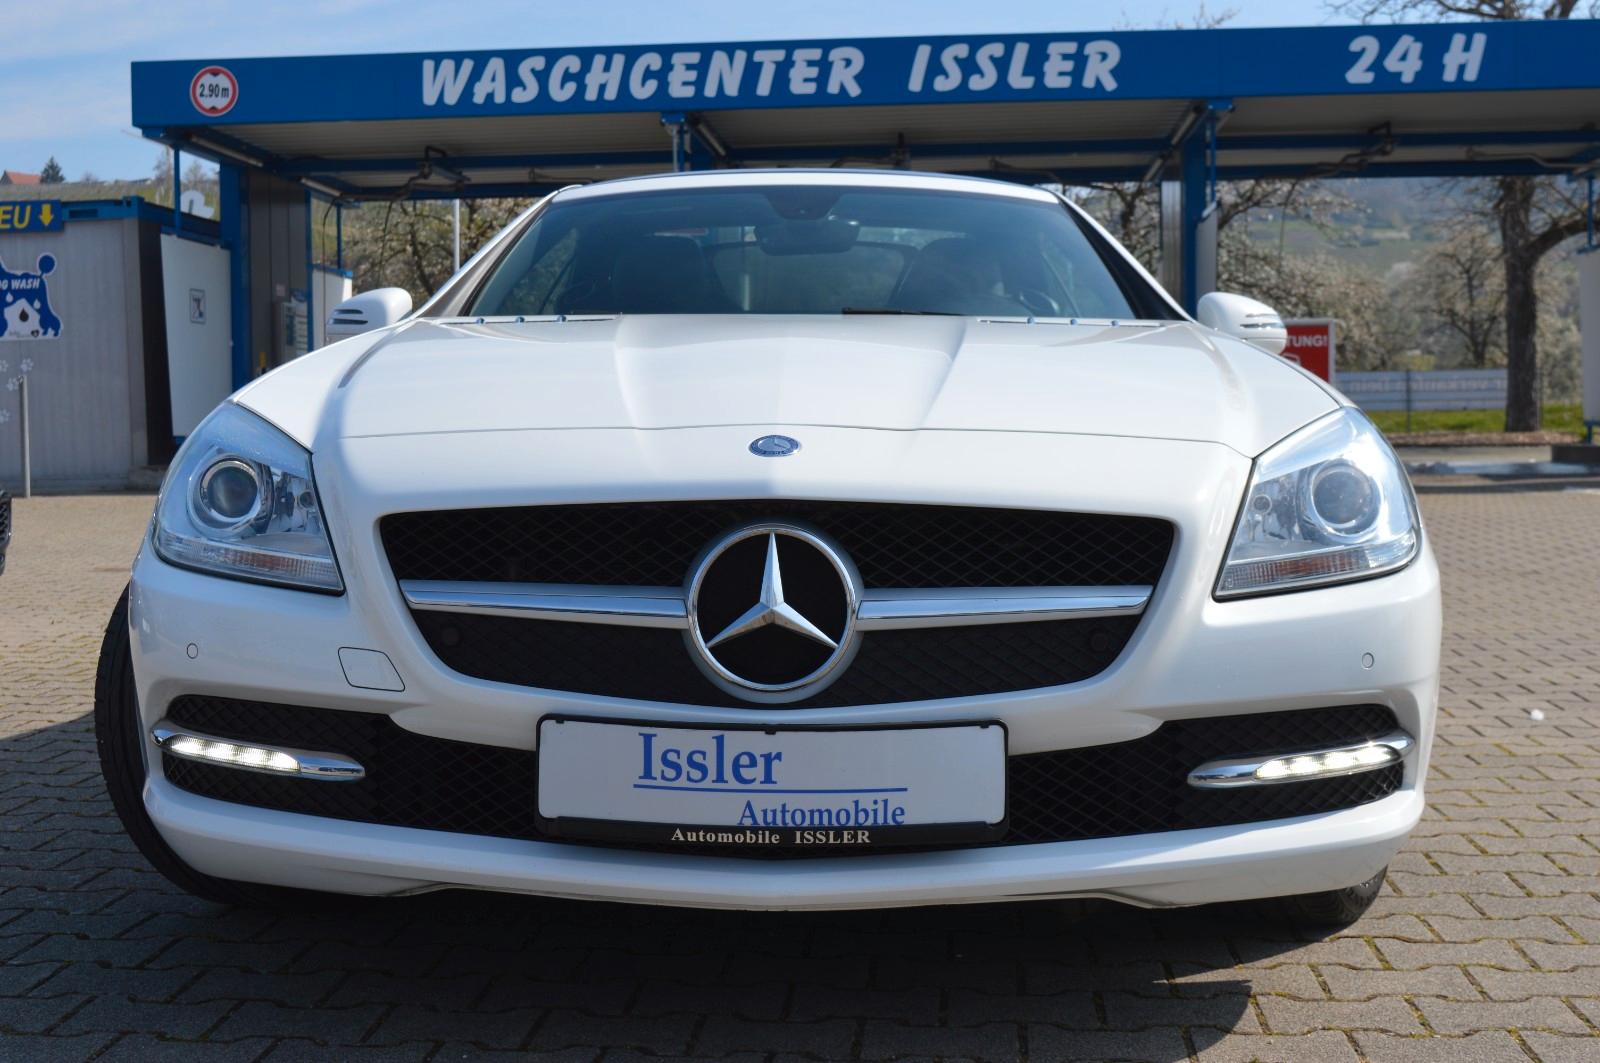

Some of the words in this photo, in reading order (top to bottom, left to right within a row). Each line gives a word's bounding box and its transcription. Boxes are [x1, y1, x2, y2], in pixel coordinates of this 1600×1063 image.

[421, 46, 865, 106] WASCHCENTER
[908, 39, 1121, 93] ISSLER
[1345, 34, 1423, 84] 24
[1442, 32, 1487, 82] H
[199, 83, 220, 98] 2.90
[11, 277, 40, 291] WASH
[638, 732, 783, 785] Issler
[738, 799, 907, 828] Automobile
[671, 828, 781, 844] Automobile
[794, 830, 871, 844] ISSLER
